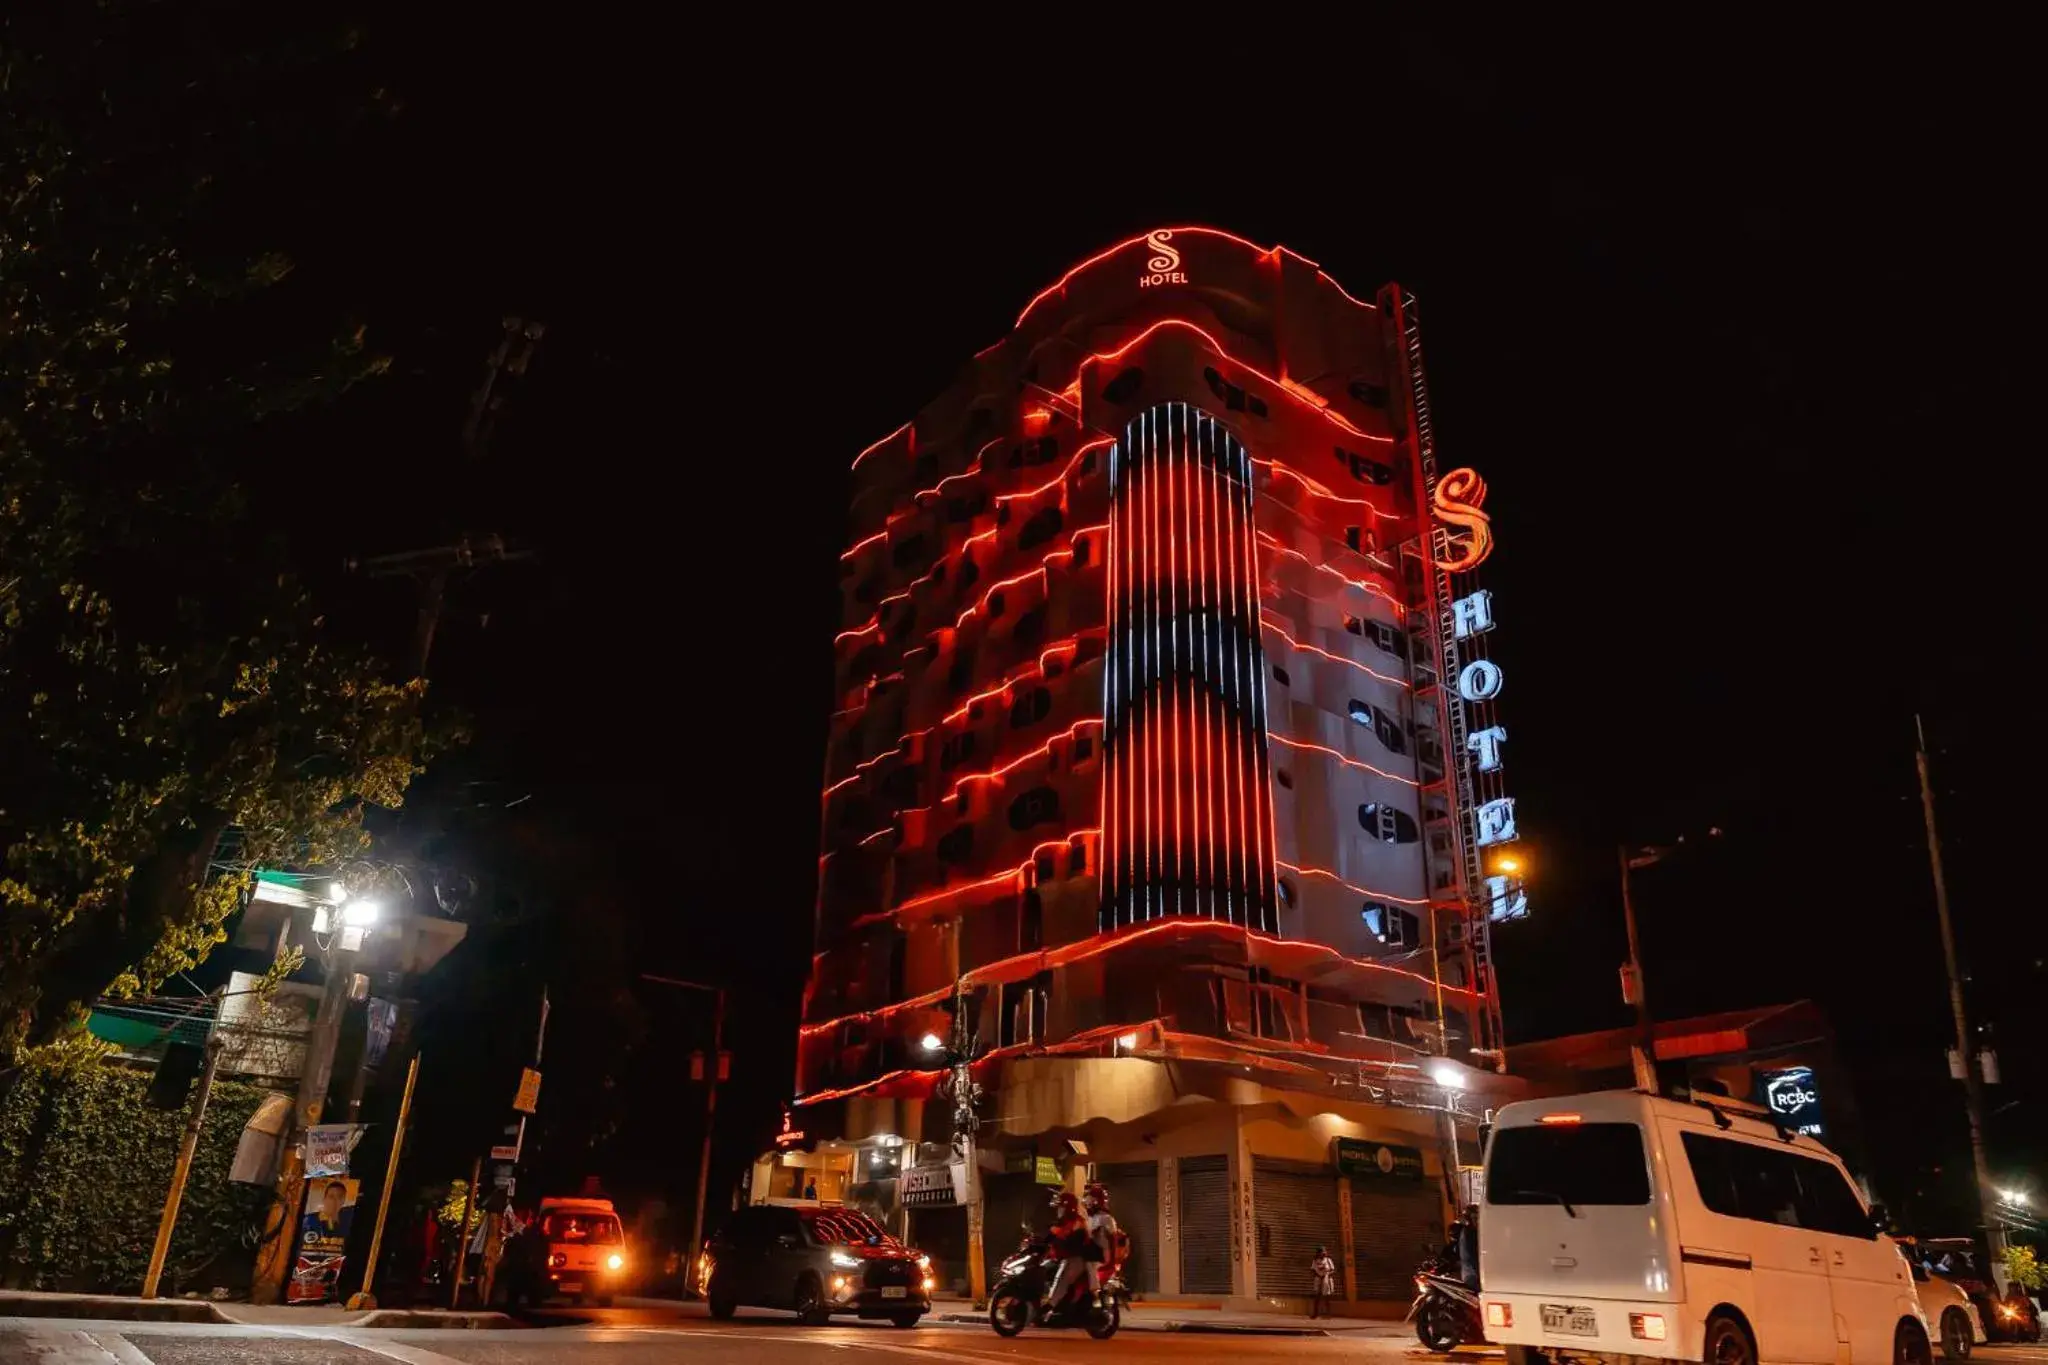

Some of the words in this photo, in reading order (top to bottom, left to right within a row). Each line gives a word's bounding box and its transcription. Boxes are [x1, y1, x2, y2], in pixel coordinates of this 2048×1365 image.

[1140, 272, 1188, 288] HOTEL
[1433, 467, 1494, 573] S
[1451, 589, 1530, 924] HOTEL
[1777, 1091, 1816, 1105] RCBC
